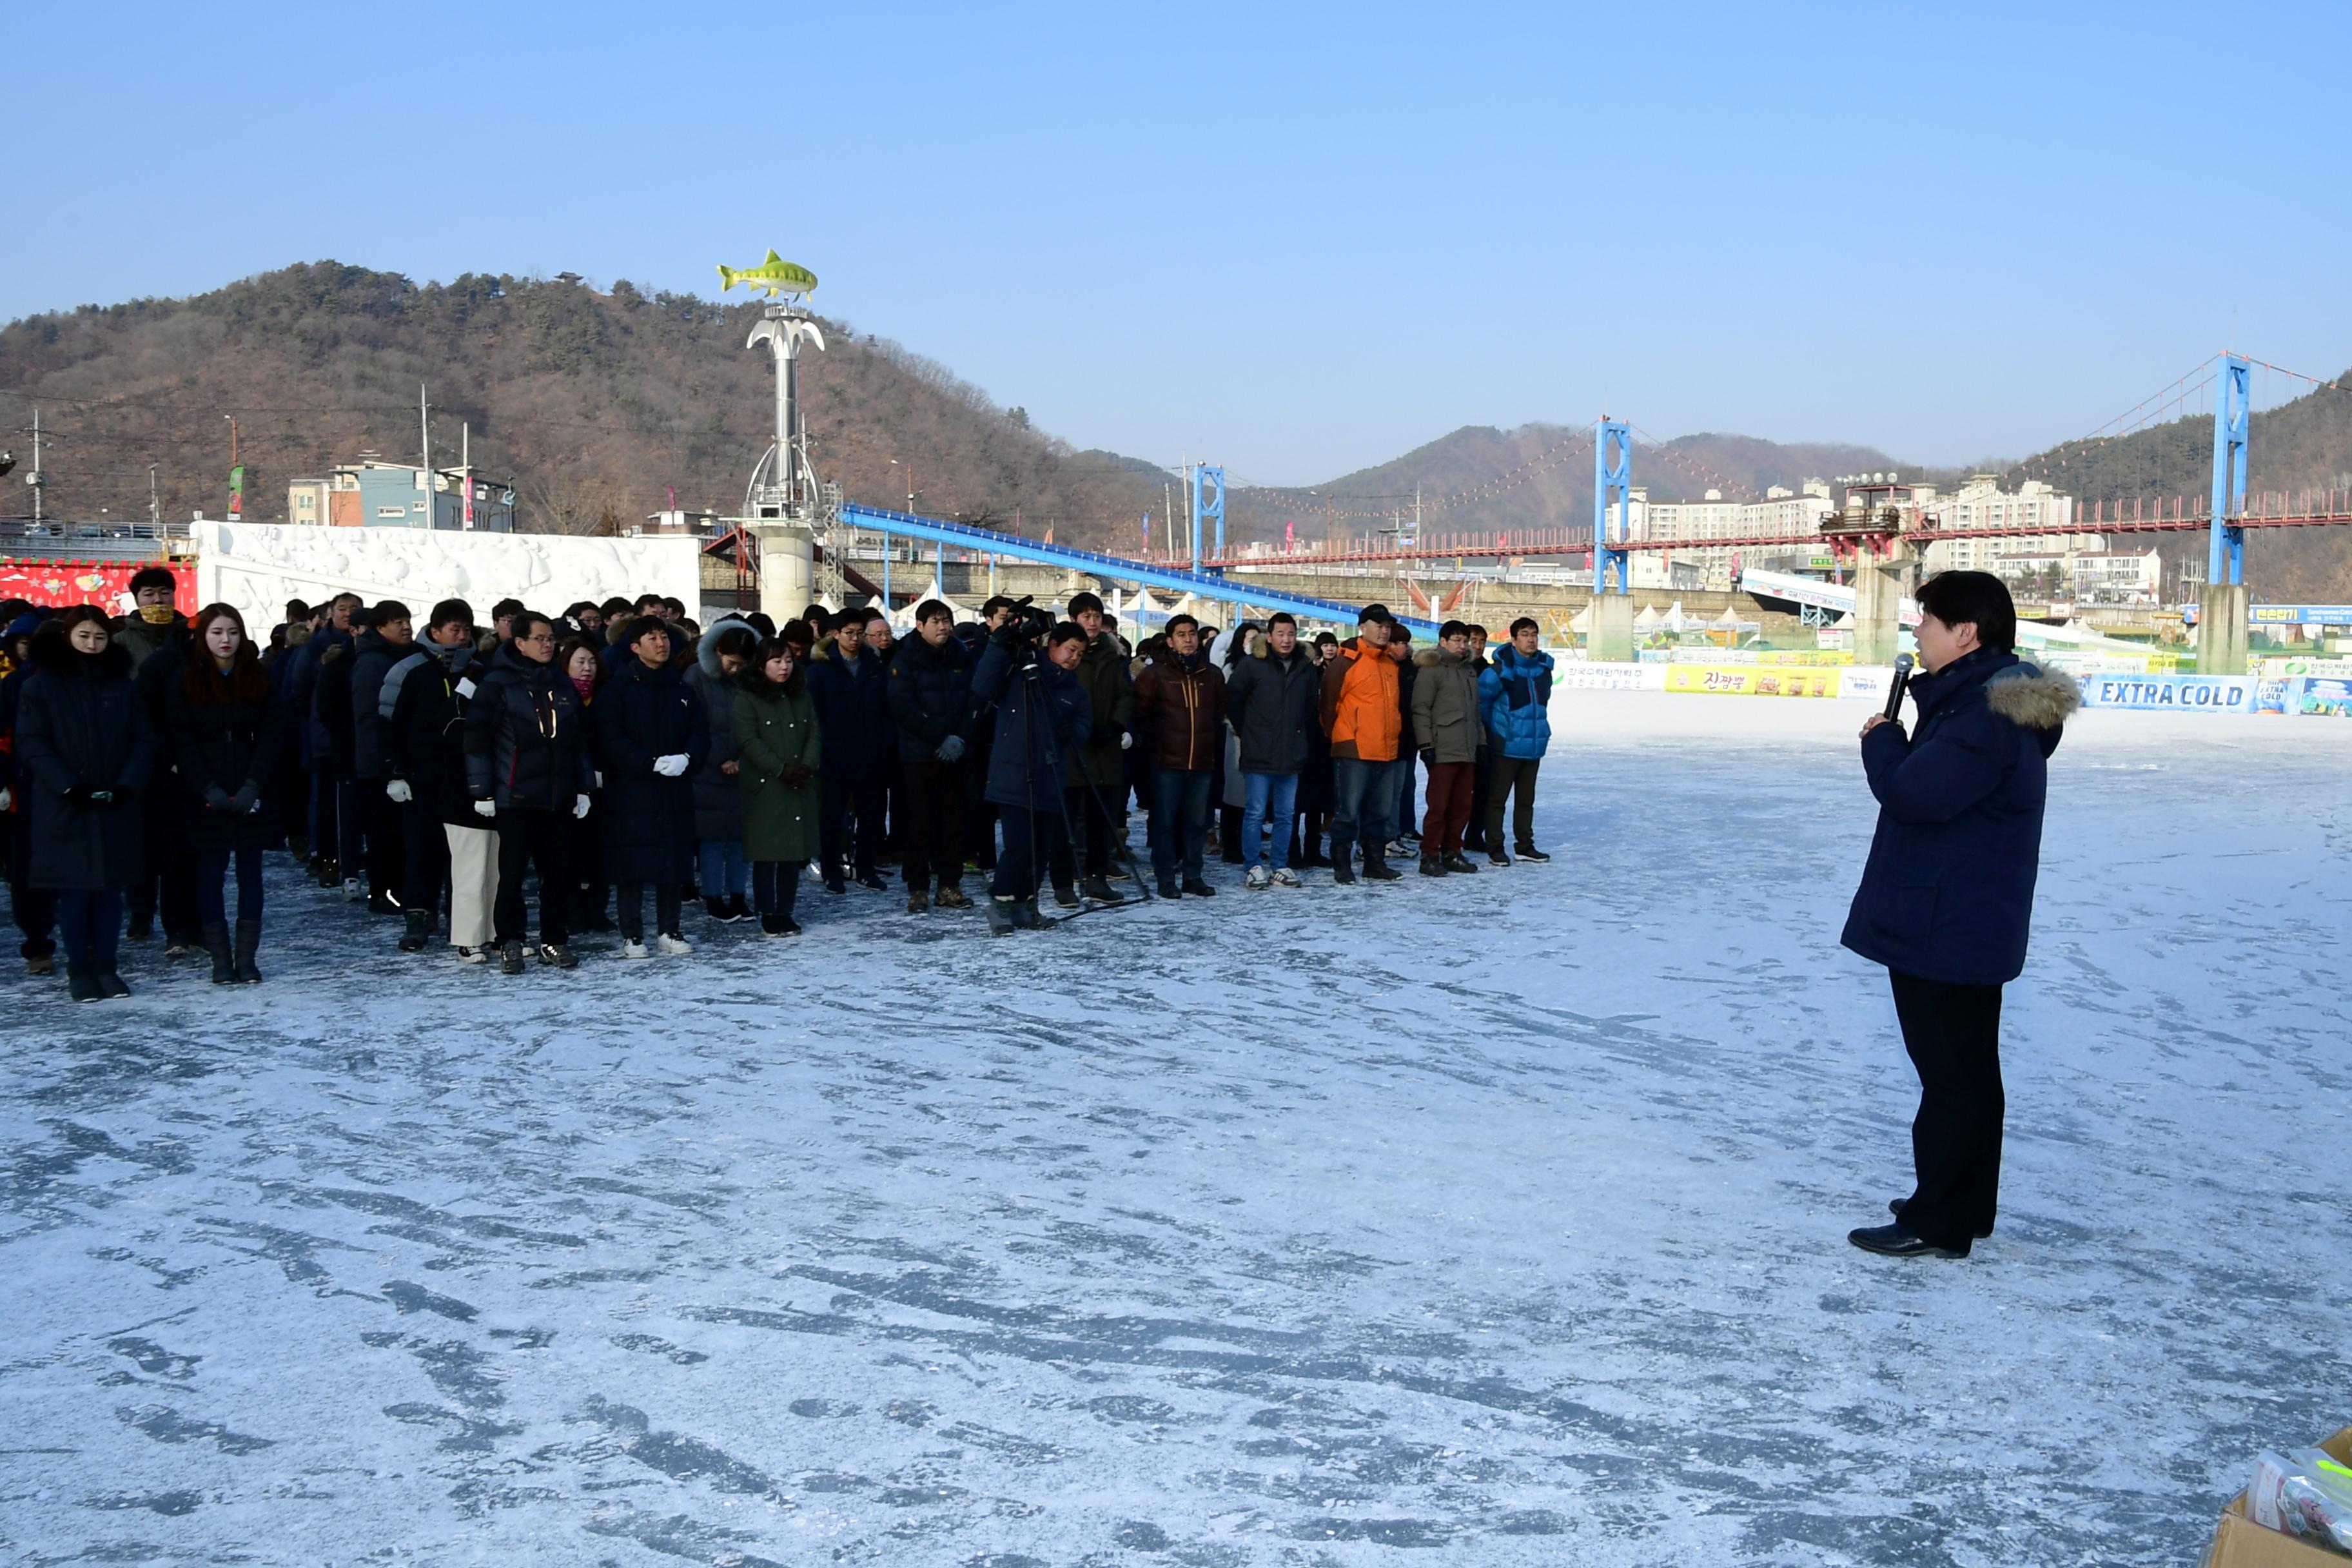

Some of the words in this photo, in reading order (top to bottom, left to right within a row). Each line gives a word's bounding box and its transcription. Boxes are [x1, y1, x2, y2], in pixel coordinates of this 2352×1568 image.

[1703, 672, 1745, 690] 진짬뽕
[2100, 682, 2173, 704] EXTRA
[2180, 685, 2244, 706] COLD
